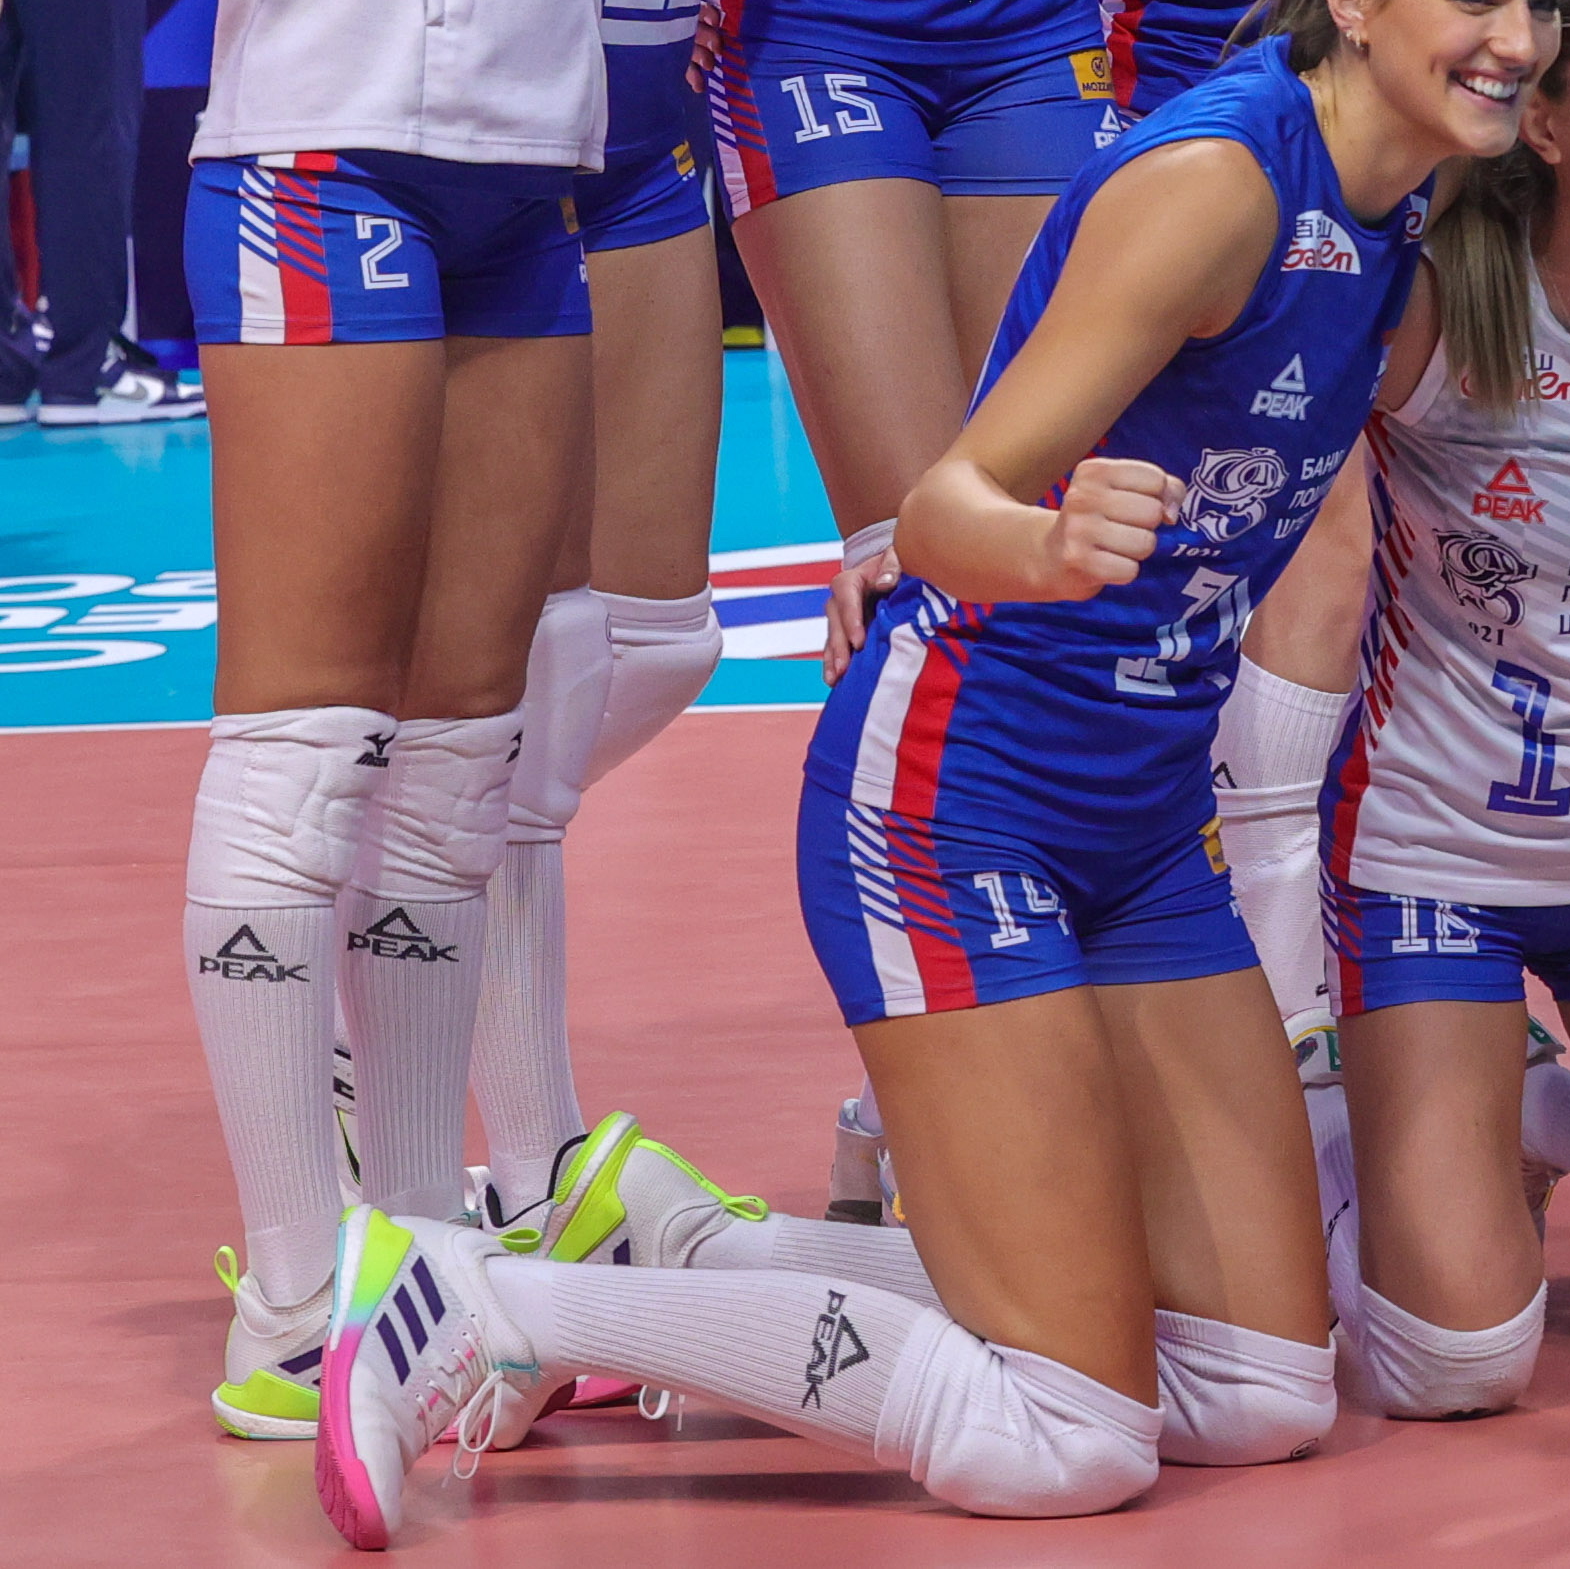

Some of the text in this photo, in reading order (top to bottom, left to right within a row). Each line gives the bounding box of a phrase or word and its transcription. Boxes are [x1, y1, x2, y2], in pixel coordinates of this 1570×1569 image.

[781, 73, 883, 144] 15
[356, 213, 409, 290] 2
[1250, 389, 1314, 422] PEAK
[1471, 492, 1550, 525] PEAK
[346, 931, 460, 963] PEAK
[200, 955, 310, 983] PEAK
[800, 1287, 848, 1411] PEAK
